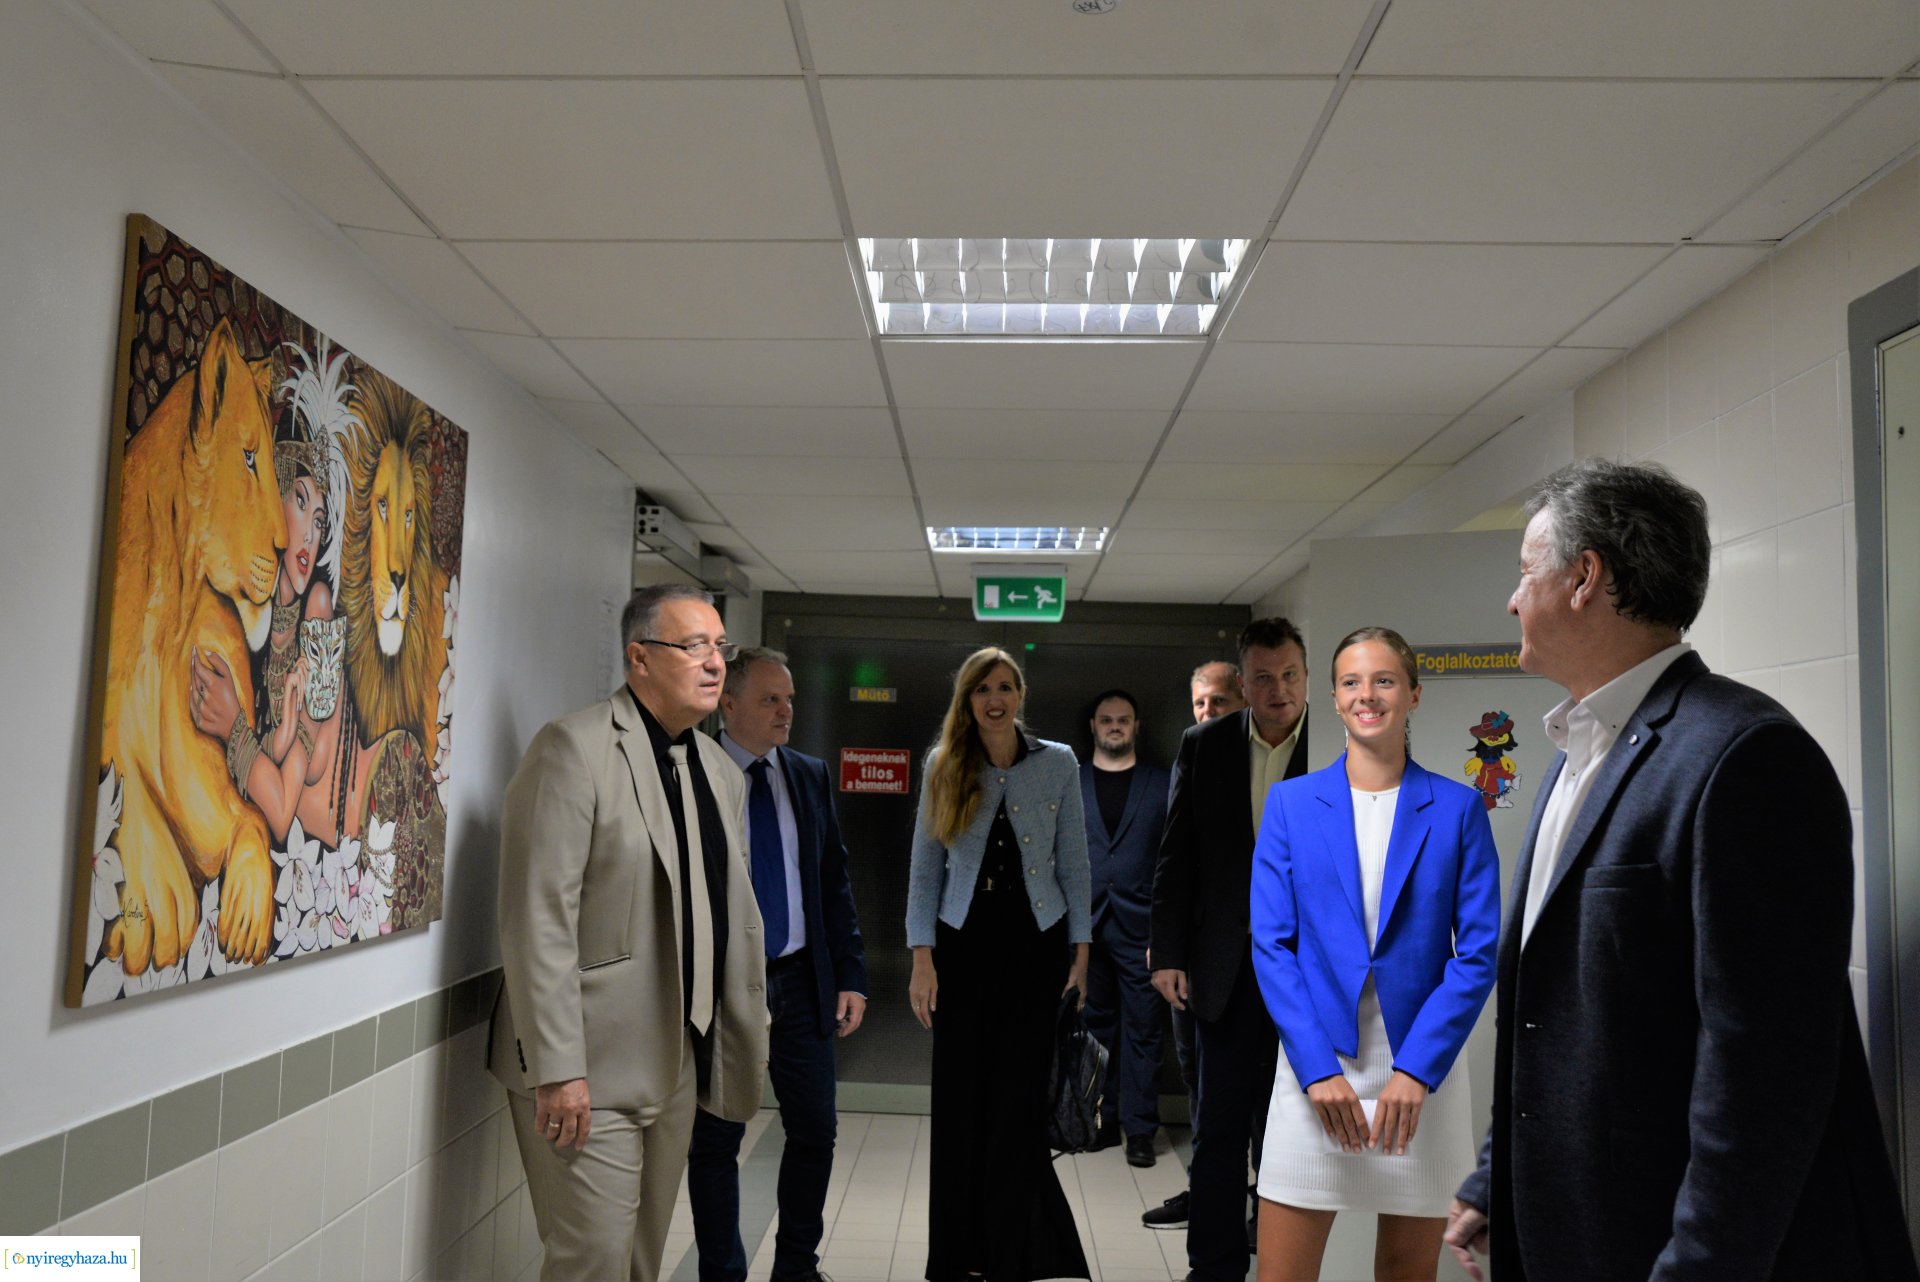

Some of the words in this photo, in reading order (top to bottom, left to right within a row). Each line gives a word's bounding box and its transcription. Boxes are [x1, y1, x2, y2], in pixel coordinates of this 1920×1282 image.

[1416, 651, 1519, 673] Foglalkoztató
[843, 751, 906, 764] Idegeneknek
[861, 766, 893, 779] tilos
[847, 781, 853, 789] a
[855, 780, 902, 791] bemenet!
